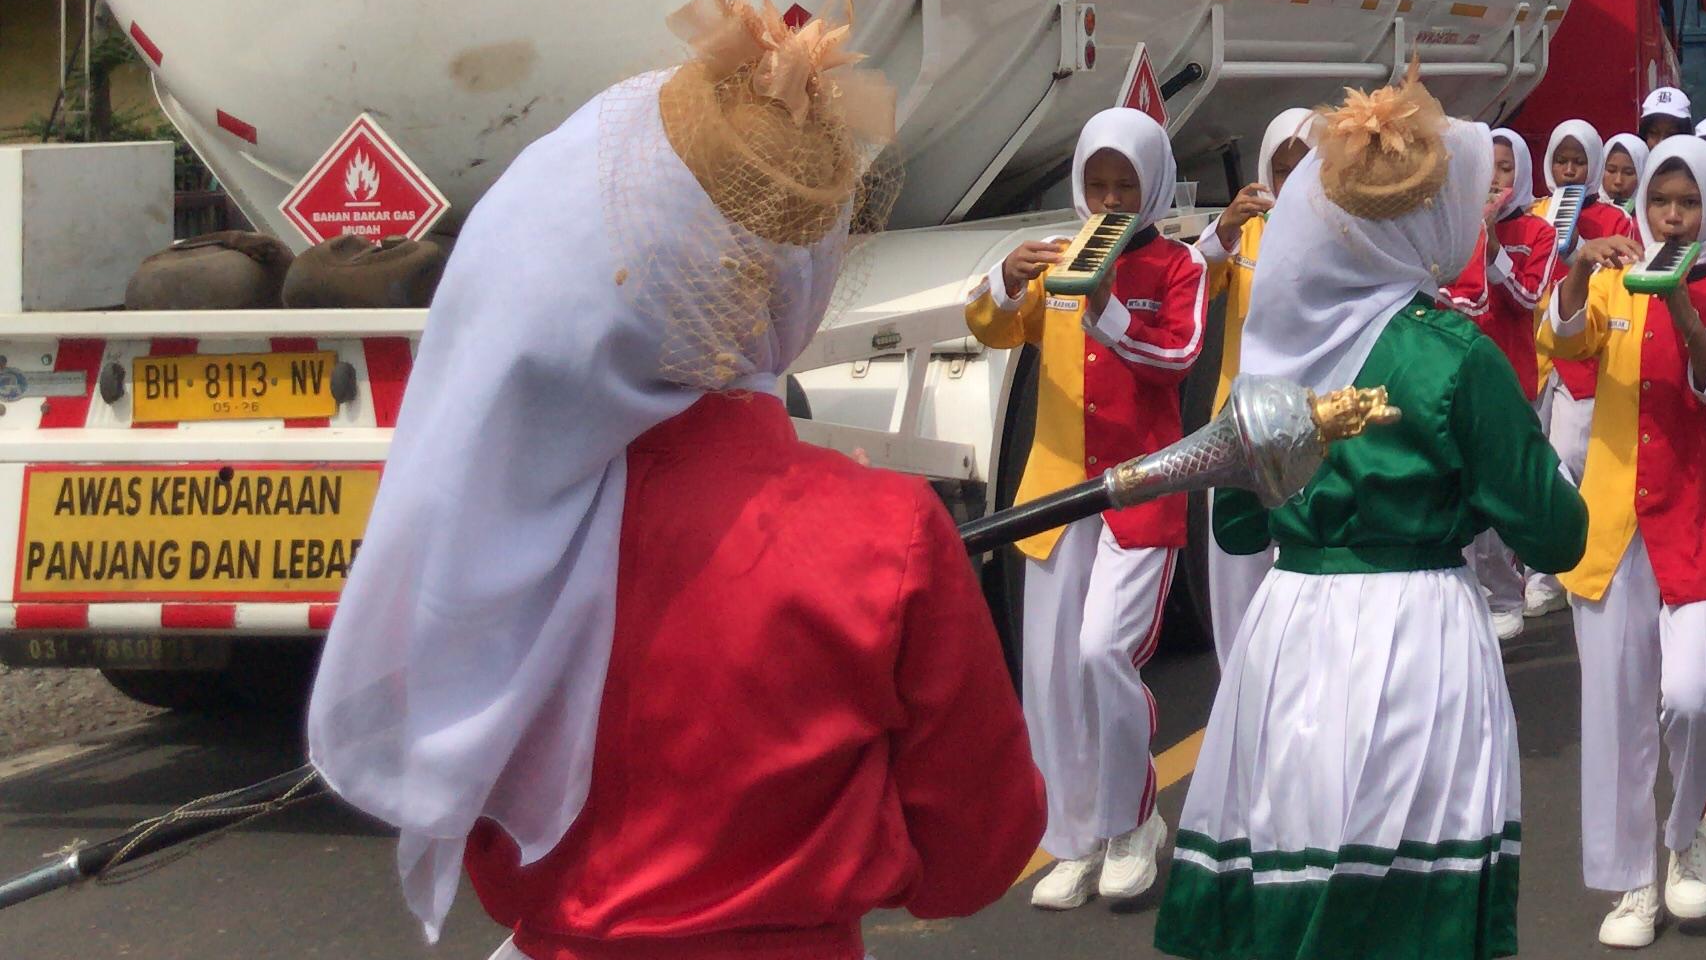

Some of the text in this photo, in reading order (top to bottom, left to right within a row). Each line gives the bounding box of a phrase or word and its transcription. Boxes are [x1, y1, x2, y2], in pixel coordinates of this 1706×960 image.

[312, 210, 416, 222] BAHAN BAKAR GAS
[342, 224, 381, 236] MUDAH
[145, 359, 325, 400] BH 8113 NV
[54, 475, 343, 517] AWAS KENDARAAN
[26, 540, 181, 581] PANJANG
[189, 539, 262, 580] DAN
